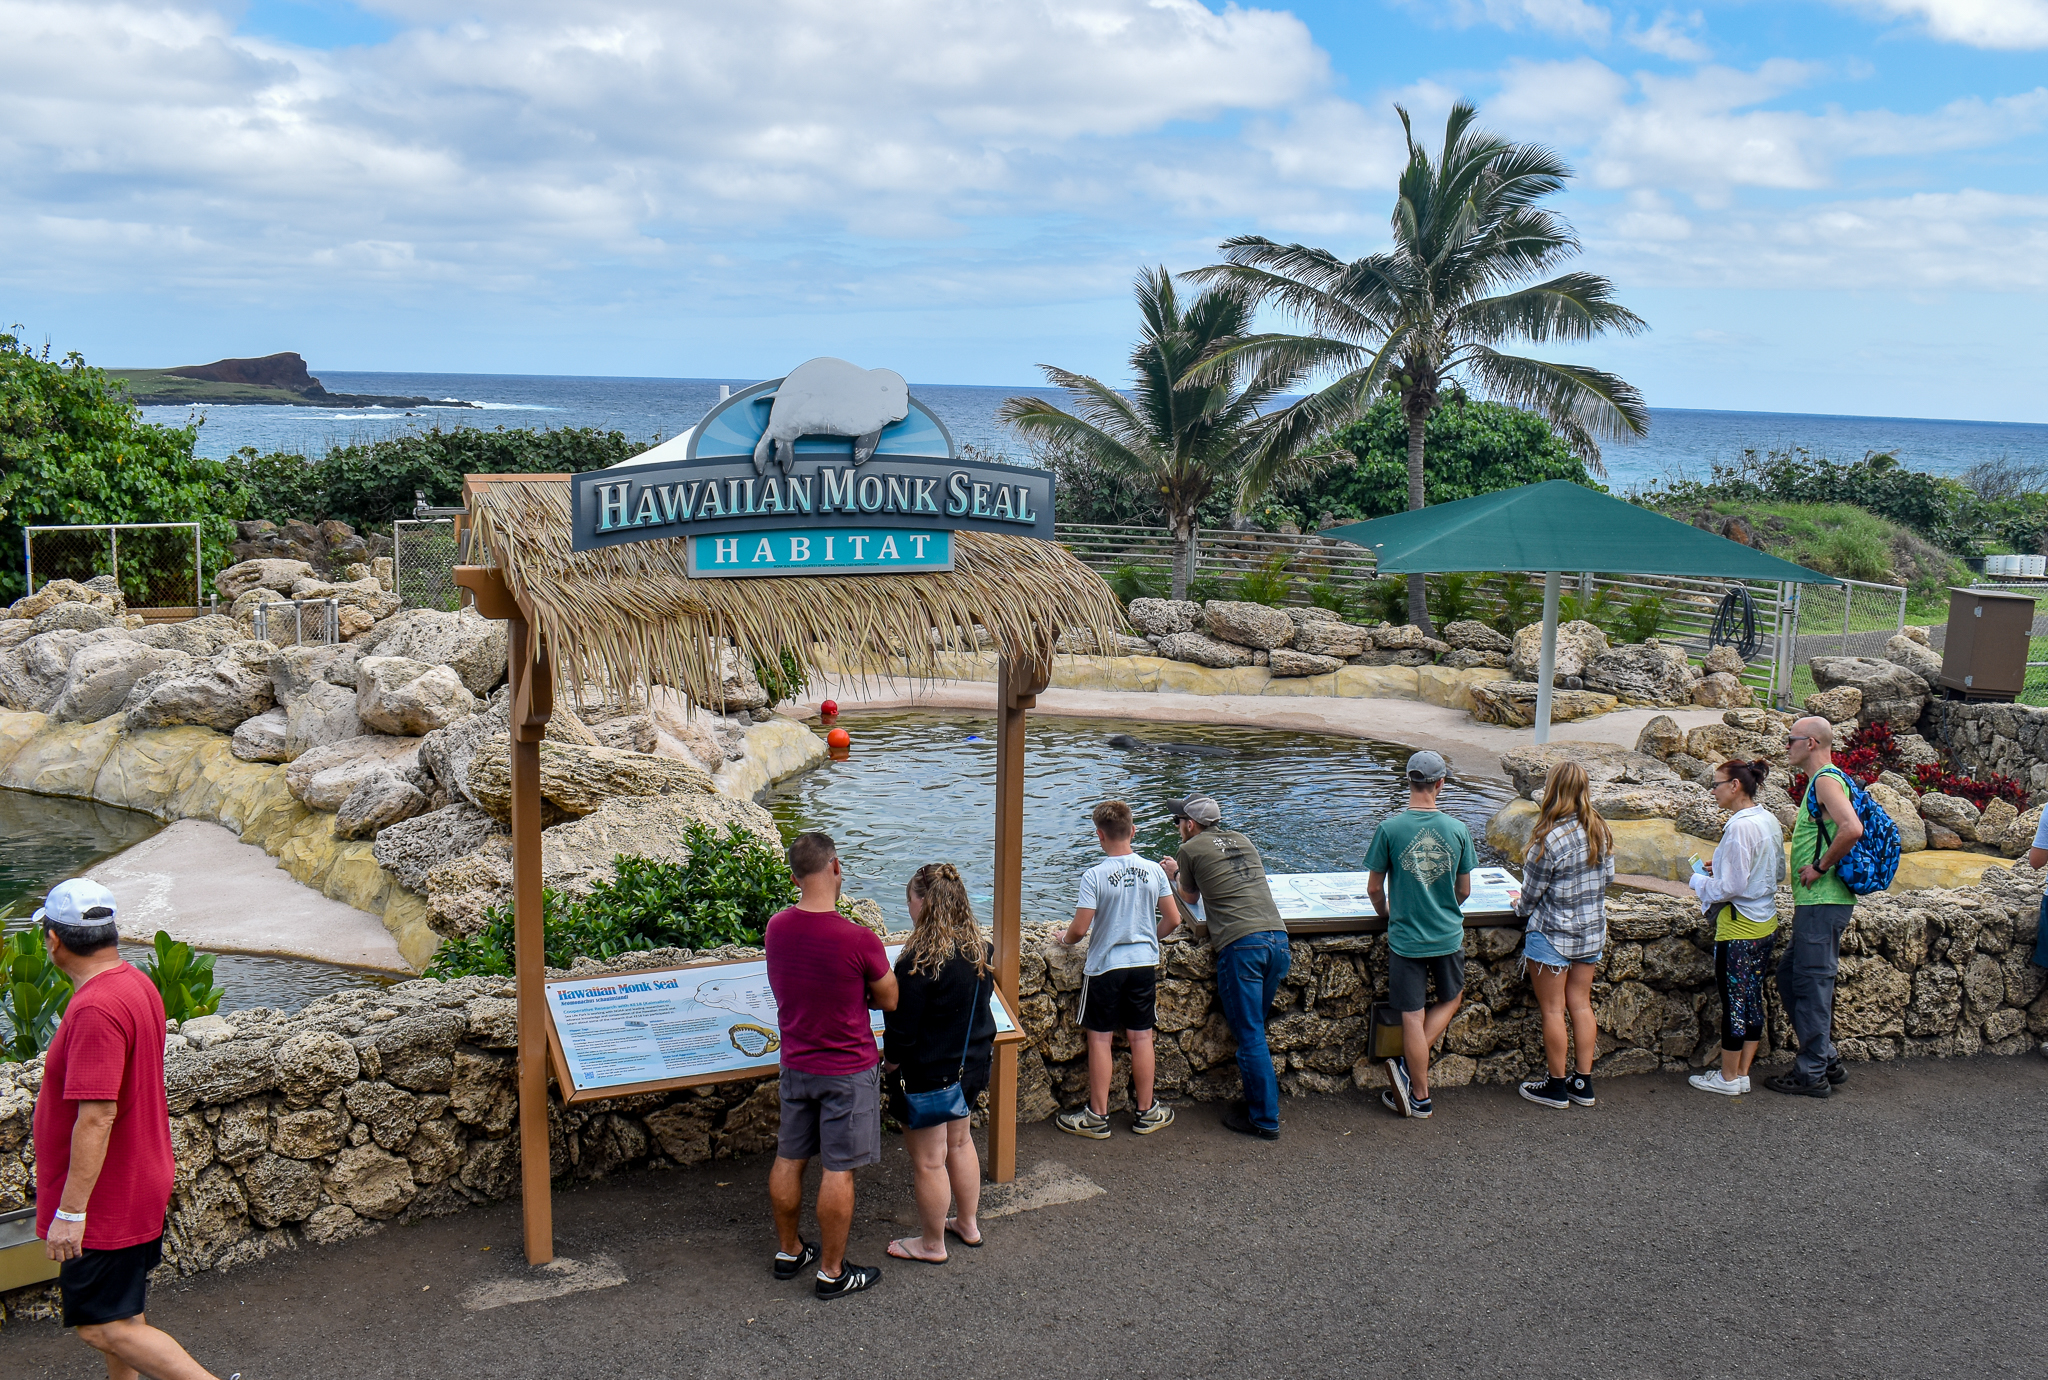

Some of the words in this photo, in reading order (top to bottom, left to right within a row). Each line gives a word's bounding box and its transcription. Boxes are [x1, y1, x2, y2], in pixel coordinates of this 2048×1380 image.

[597, 475, 813, 531] HAWAIIAN
[820, 468, 940, 512] MONK
[948, 470, 1036, 522] SEAL
[714, 535, 931, 563] HABITAT
[557, 986, 617, 1000] Hawaiian
[618, 981, 652, 994] Monk
[653, 979, 679, 990] Seal
